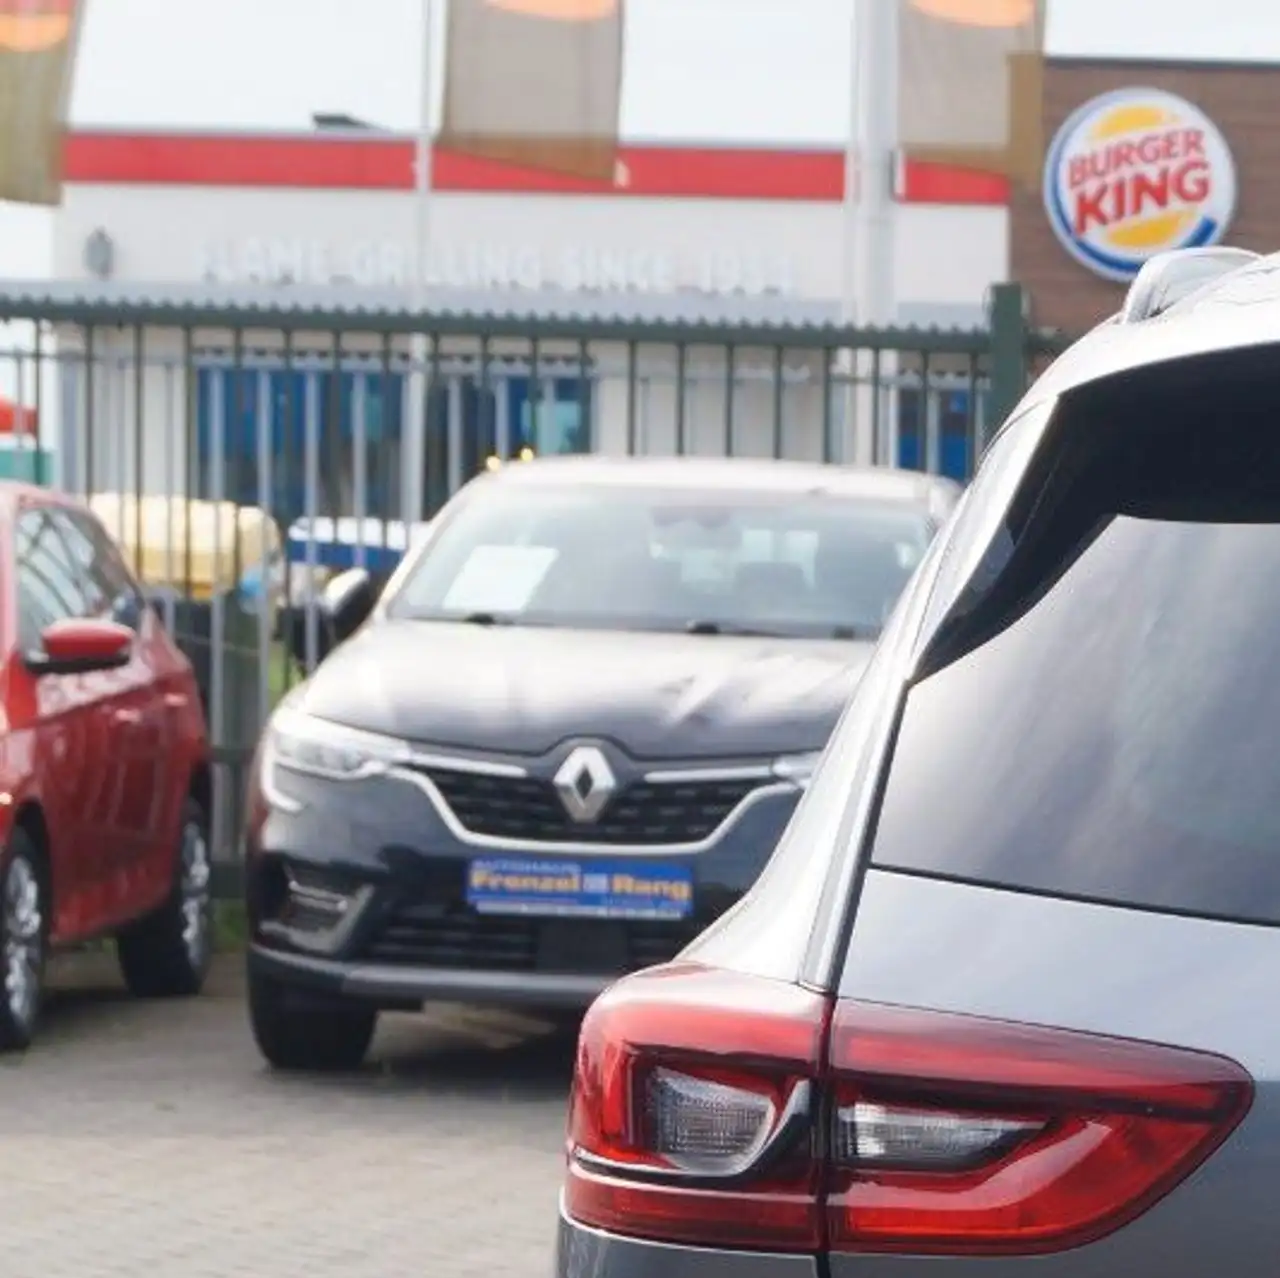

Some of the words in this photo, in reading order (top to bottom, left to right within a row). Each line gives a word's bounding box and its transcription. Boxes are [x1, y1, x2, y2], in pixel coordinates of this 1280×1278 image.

[1069, 130, 1205, 188] BURGER
[1075, 161, 1211, 237] KING
[471, 870, 580, 893] Frenzel
[612, 874, 692, 901] Rang
